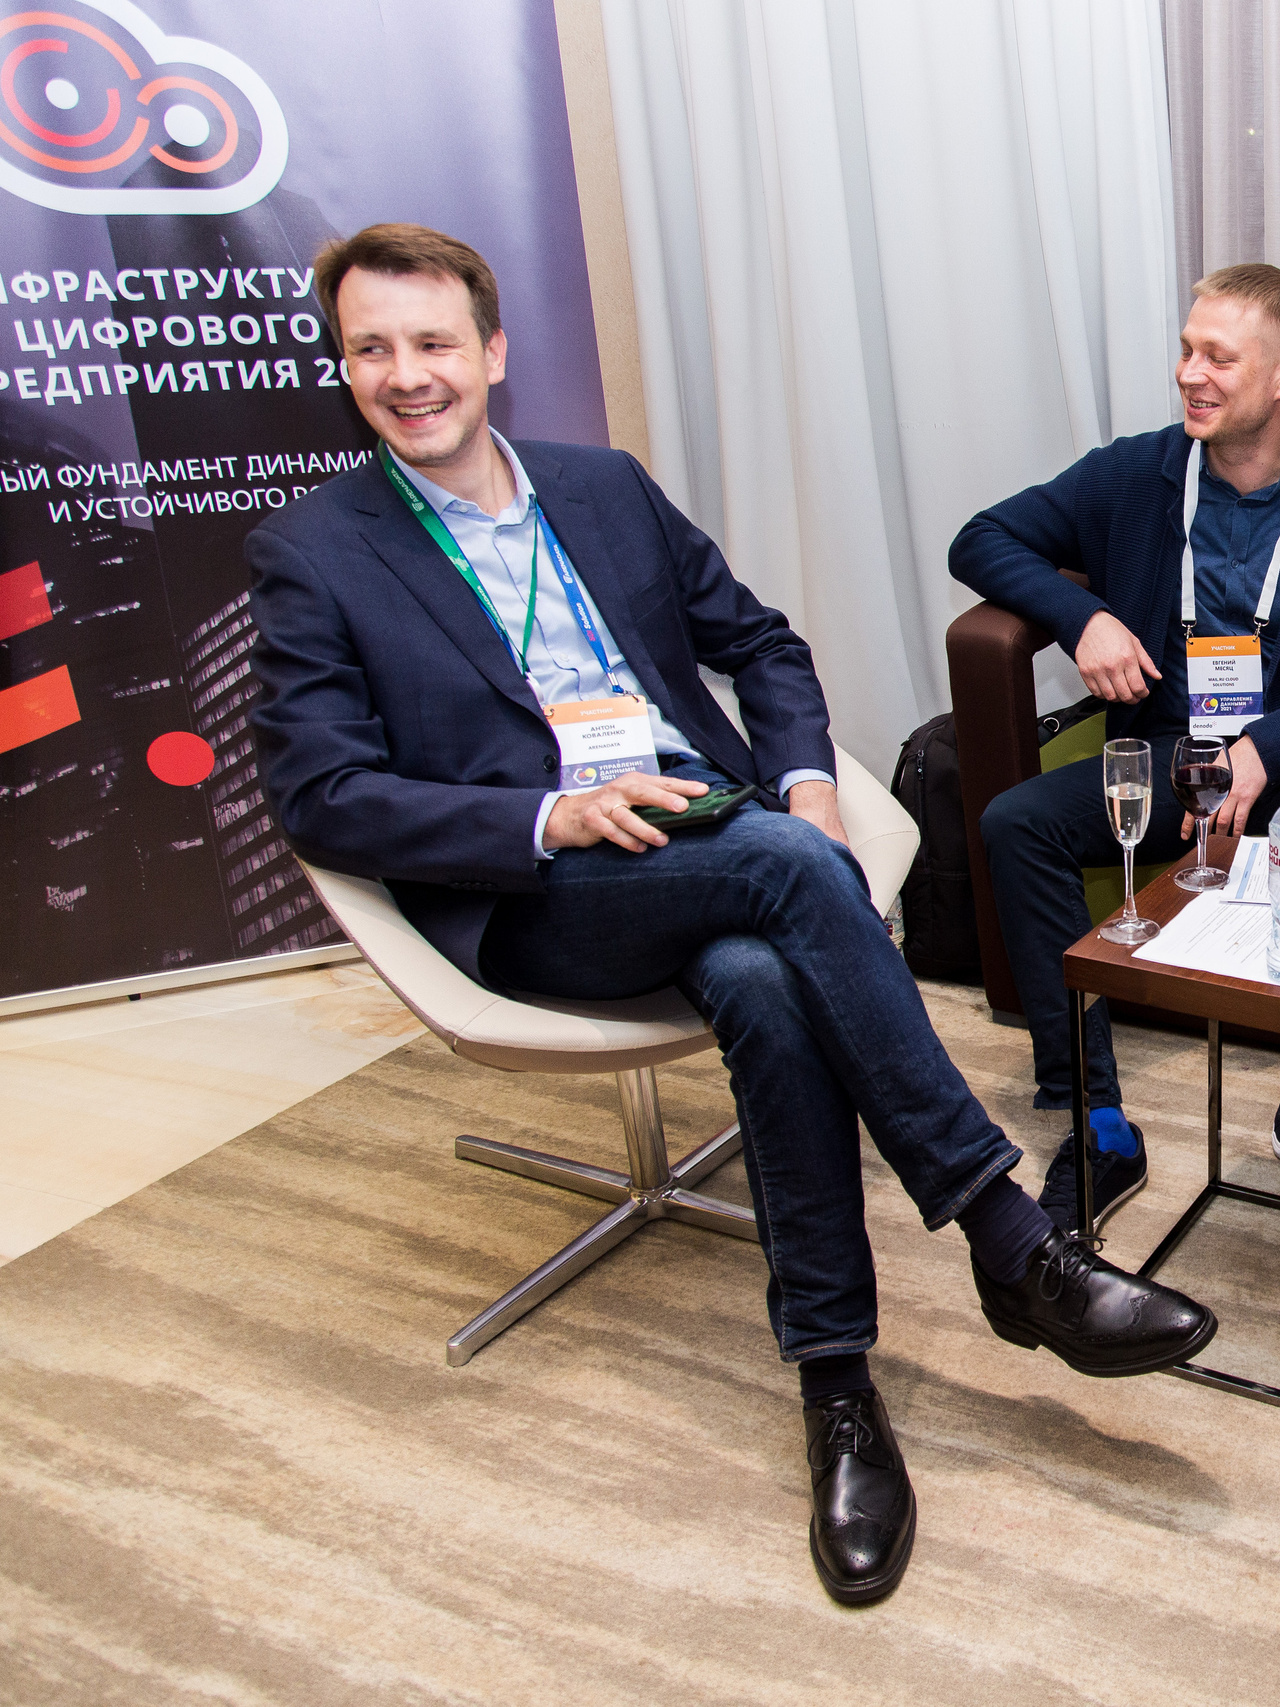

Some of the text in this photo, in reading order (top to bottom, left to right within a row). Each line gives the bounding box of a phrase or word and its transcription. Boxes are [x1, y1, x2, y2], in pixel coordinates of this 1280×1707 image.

[14, 313, 320, 358] ЦИФРОВОГО
[0, 450, 373, 493] ЫЙ ФУНДАМЕНТ ДИНАМИ
[391, 467, 420, 505] ARENADATA
[48, 501, 72, 523] И
[78, 485, 287, 521] УСТОЙЧИВОГО
[576, 602, 591, 630] Solution
[579, 707, 614, 716] УЧАСТНИК
[590, 724, 616, 732] АНТОН
[582, 729, 626, 740] КОВАЛЕНКО
[588, 742, 621, 750] ARENADATA
[599, 760, 644, 770] УПРАВЛЕНИЕ
[600, 767, 636, 777] ДАННЫМИ
